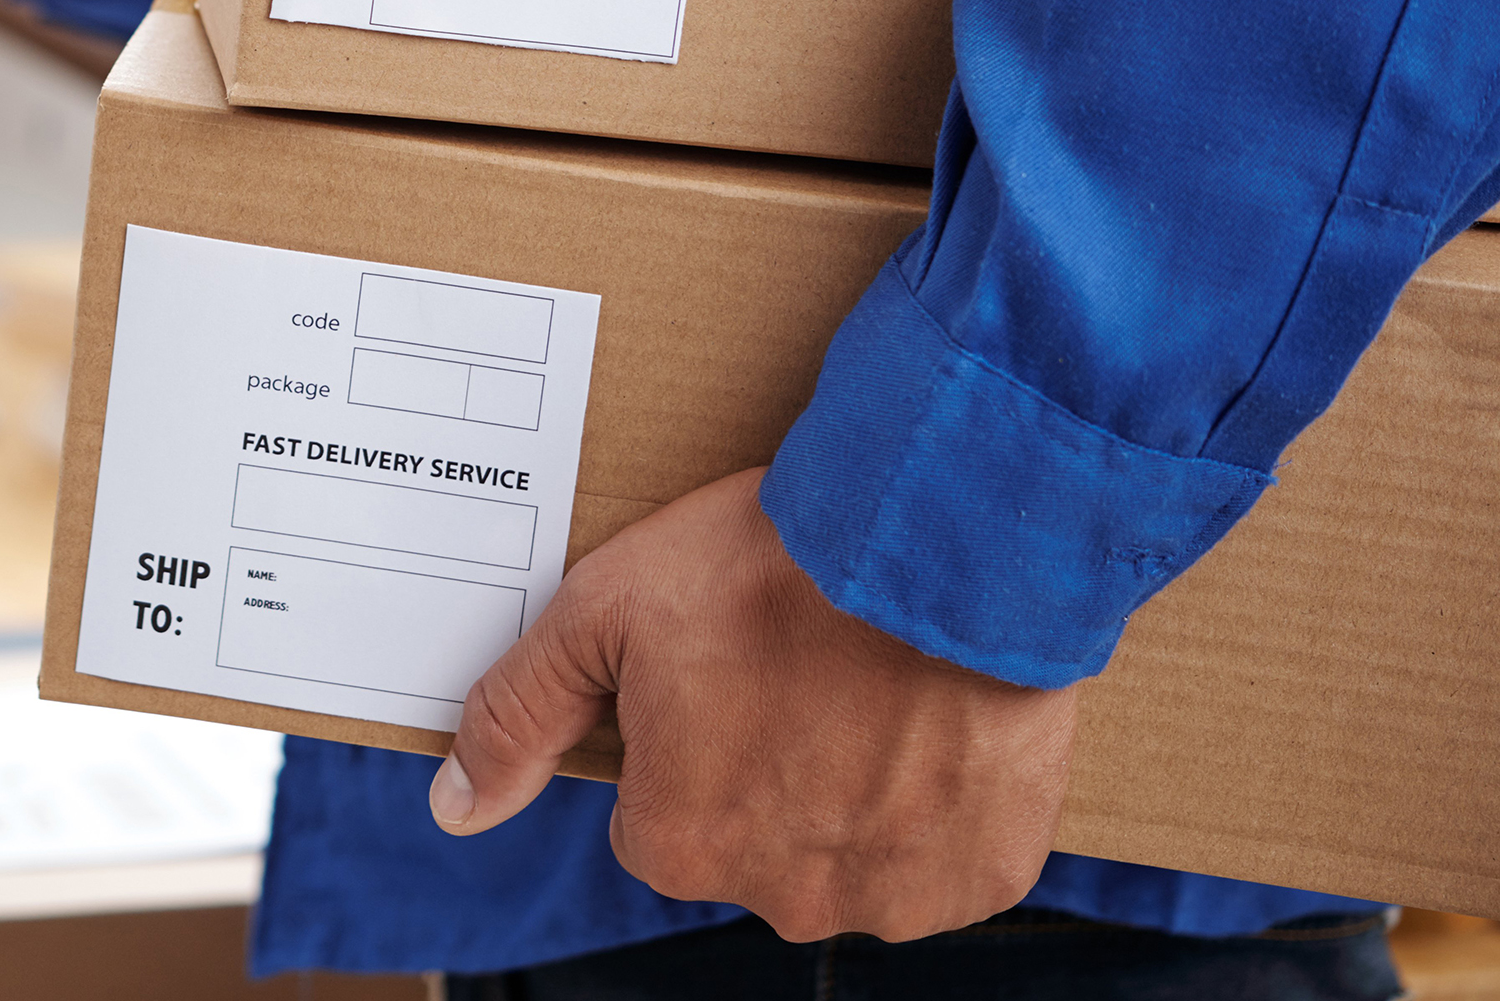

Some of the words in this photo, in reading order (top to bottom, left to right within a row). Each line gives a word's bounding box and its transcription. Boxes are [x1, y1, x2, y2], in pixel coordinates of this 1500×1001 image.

[291, 312, 340, 332] code
[247, 375, 331, 400] package
[242, 432, 302, 457] FAST
[306, 441, 425, 475] DELIVERY
[429, 458, 530, 491] SERVICE
[136, 552, 211, 589] SHIP
[247, 569, 277, 582] NAME:
[243, 597, 289, 612] ADDRESS:
[132, 600, 183, 636] TO:
